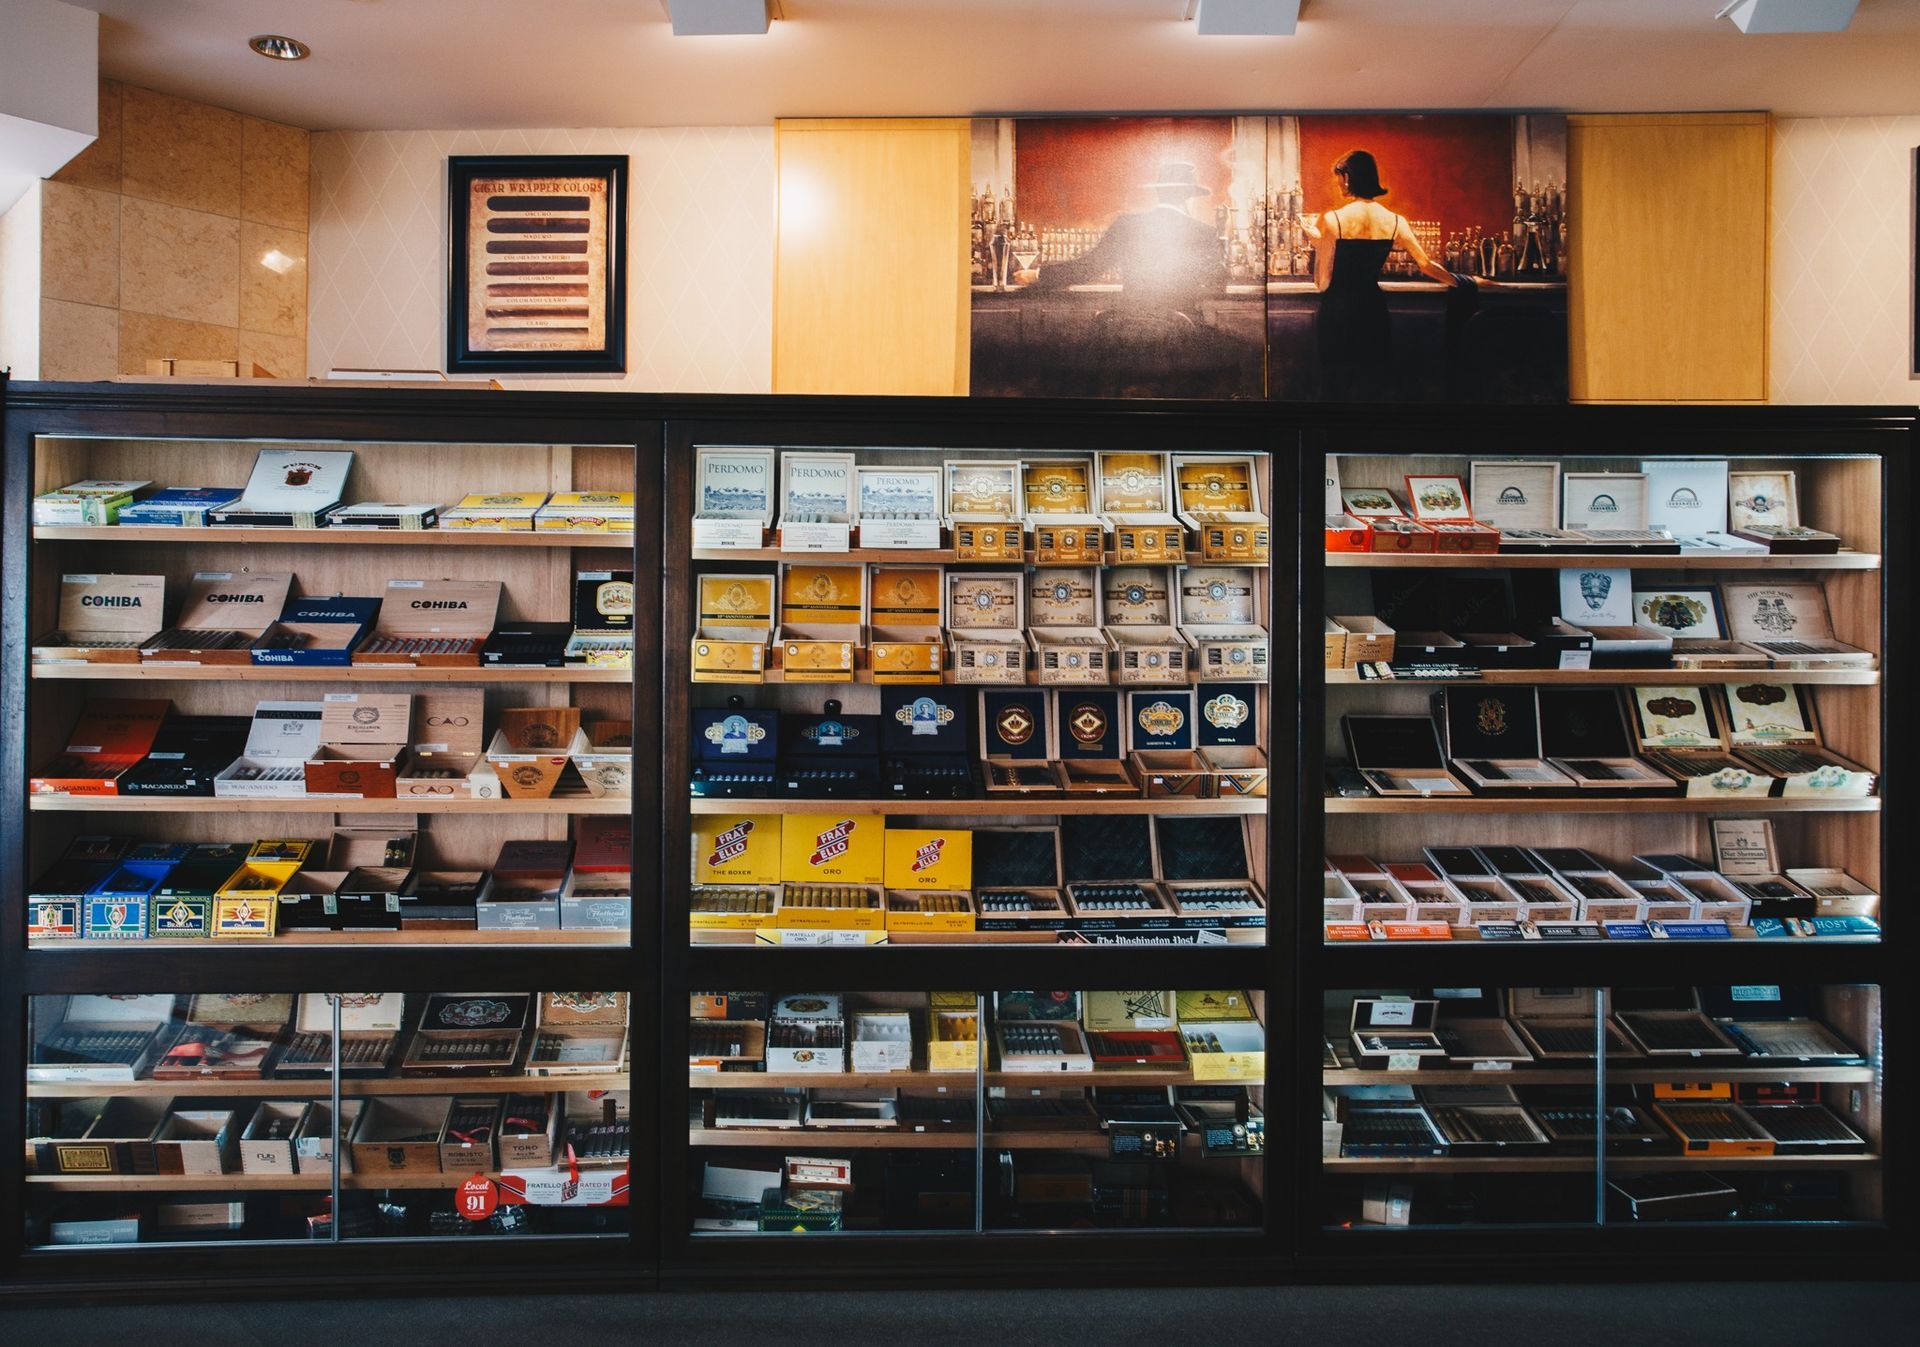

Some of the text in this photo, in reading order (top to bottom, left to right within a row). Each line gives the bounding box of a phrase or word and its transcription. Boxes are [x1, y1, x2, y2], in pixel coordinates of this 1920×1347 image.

[474, 183, 603, 193] CIGAR WRAPPER COLORS
[282, 462, 322, 470] PUNCH
[708, 463, 764, 474] PERDOMO
[791, 467, 846, 478] PERDOMO
[877, 477, 920, 485] PERDOMO
[81, 595, 141, 607] COHIBA
[206, 594, 264, 603] COHIBA
[411, 600, 468, 610] COHIBA
[258, 654, 294, 662] COHIBA
[426, 716, 469, 727] CAO
[410, 785, 454, 795] CAO
[719, 827, 746, 844] FRAT
[820, 826, 847, 844] FRAT
[718, 842, 745, 860] ELLO
[819, 842, 847, 860] ELLO
[918, 842, 938, 856] FRAT
[918, 854, 939, 868] ELLO
[1816, 920, 1848, 929] HOST
[1097, 934, 1194, 944] The Washington Post
[464, 1180, 490, 1190] Local
[466, 1195, 485, 1210] 91
